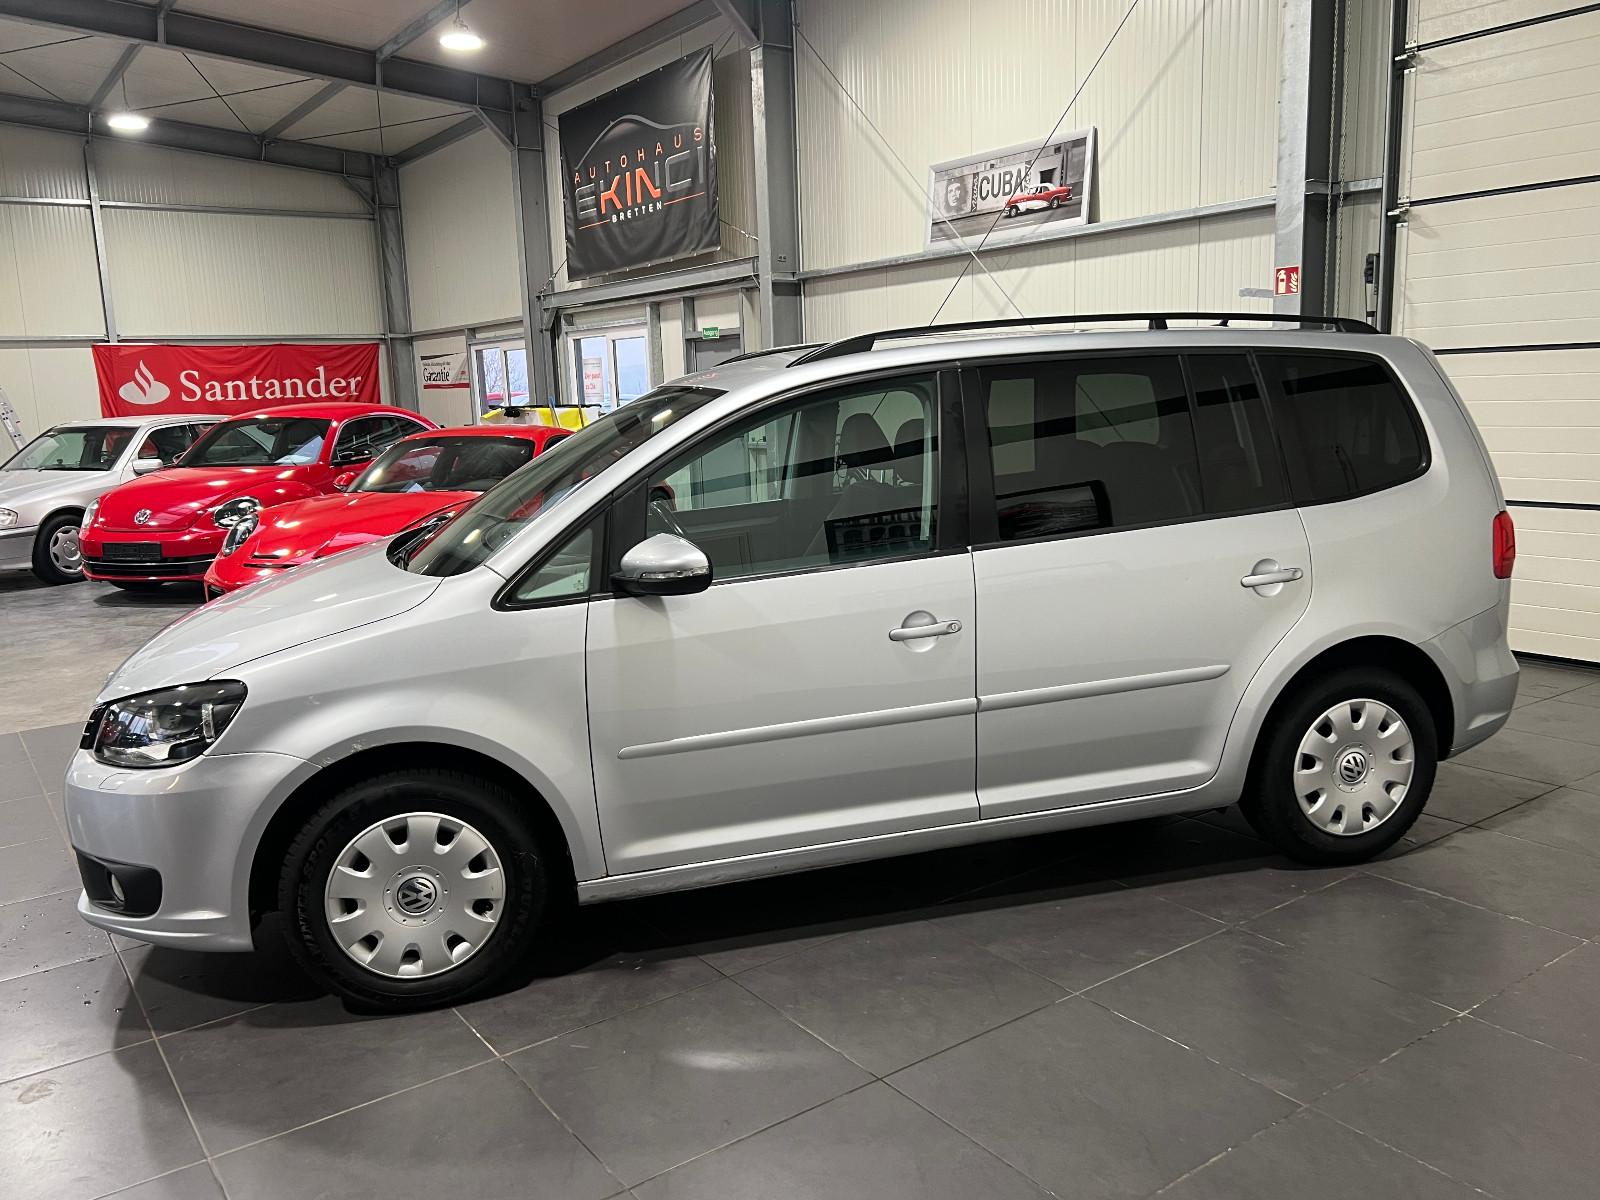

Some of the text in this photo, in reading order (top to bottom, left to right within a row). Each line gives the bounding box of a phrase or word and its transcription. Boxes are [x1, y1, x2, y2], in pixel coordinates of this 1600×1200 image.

[574, 127, 703, 185] AUTOHAUS
[575, 146, 704, 220] EKINCI
[980, 168, 1023, 201] CUBA
[612, 201, 662, 223] BRETTEN
[179, 365, 362, 402] Santander
